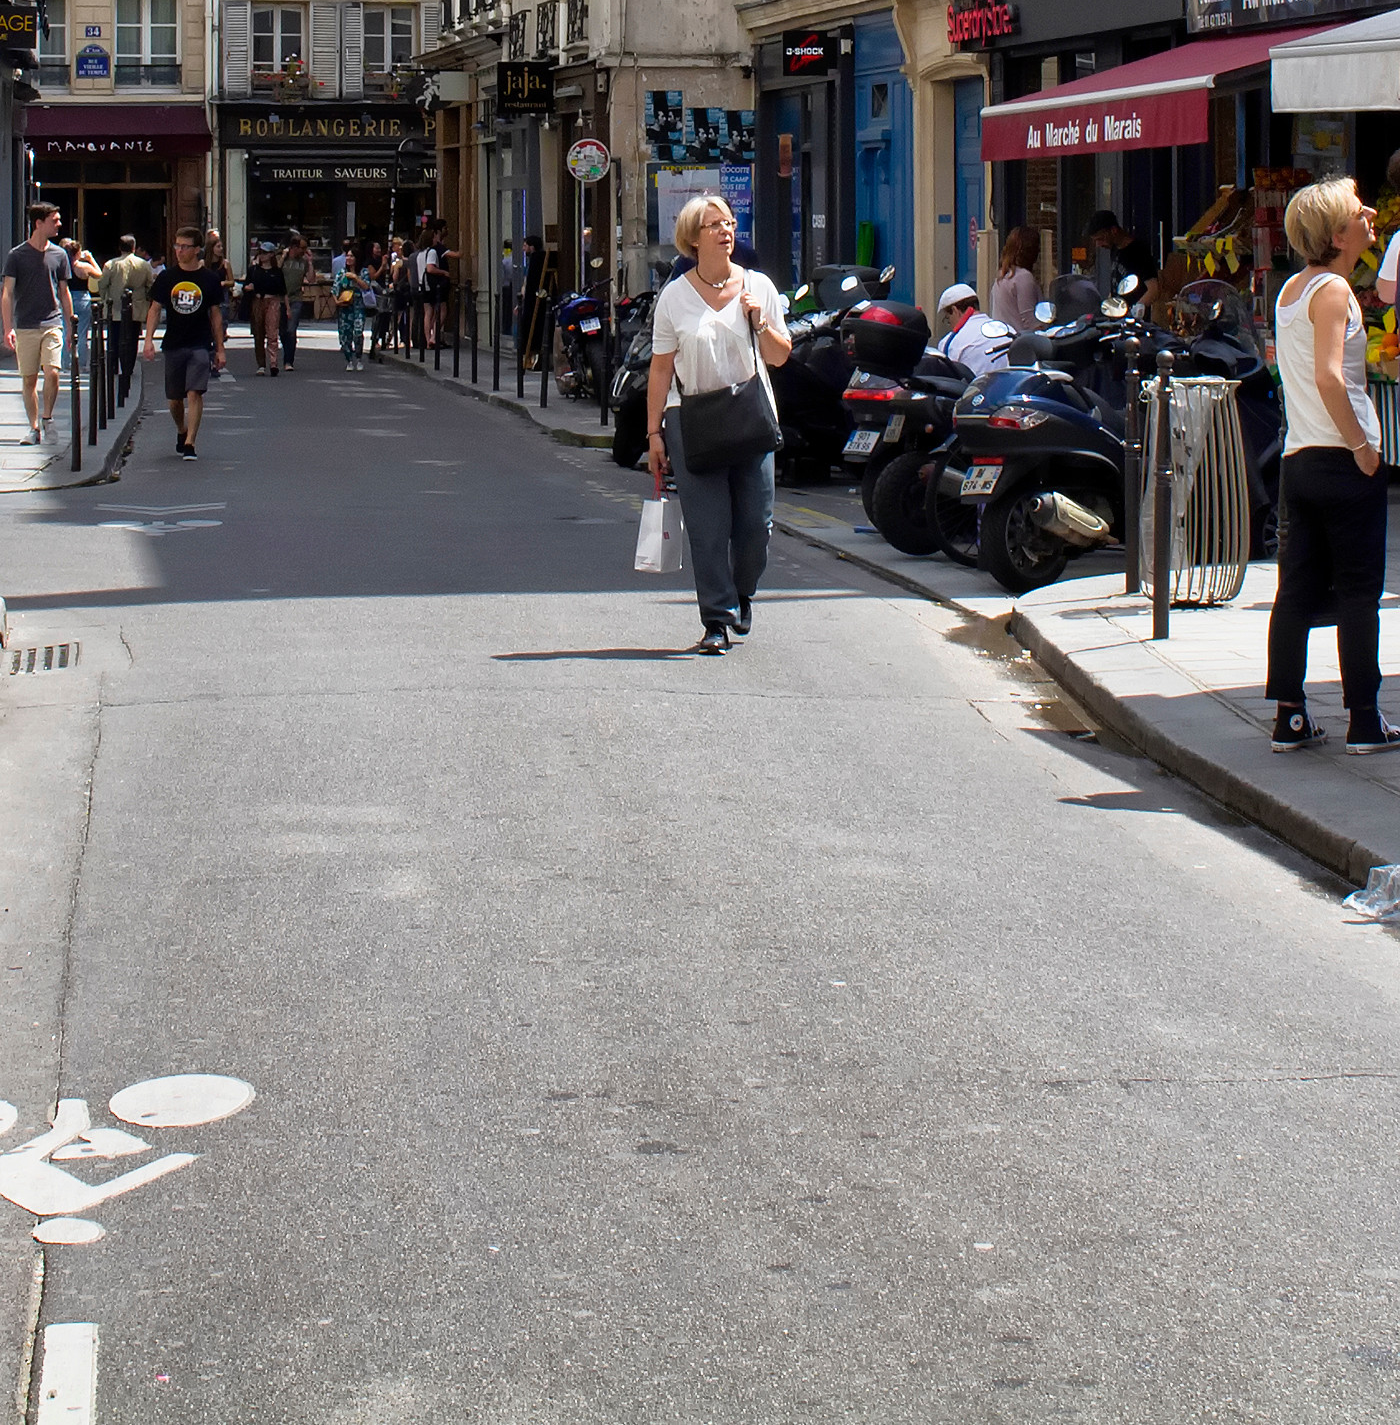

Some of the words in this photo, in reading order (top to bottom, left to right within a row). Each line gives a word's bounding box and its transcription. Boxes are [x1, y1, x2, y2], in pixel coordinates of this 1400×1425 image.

[87, 26, 100, 36] 34
[786, 47, 824, 56] G-SHOCK
[239, 118, 401, 137] BOULANGERIE
[1027, 125, 1042, 149] Au
[1045, 117, 1080, 146] Marché
[1085, 117, 1099, 141] du
[1103, 111, 1143, 141] Marais
[272, 168, 323, 179] TRAITEUR
[334, 168, 388, 179] SAVEURS
[812, 214, 826, 229] CASIO
